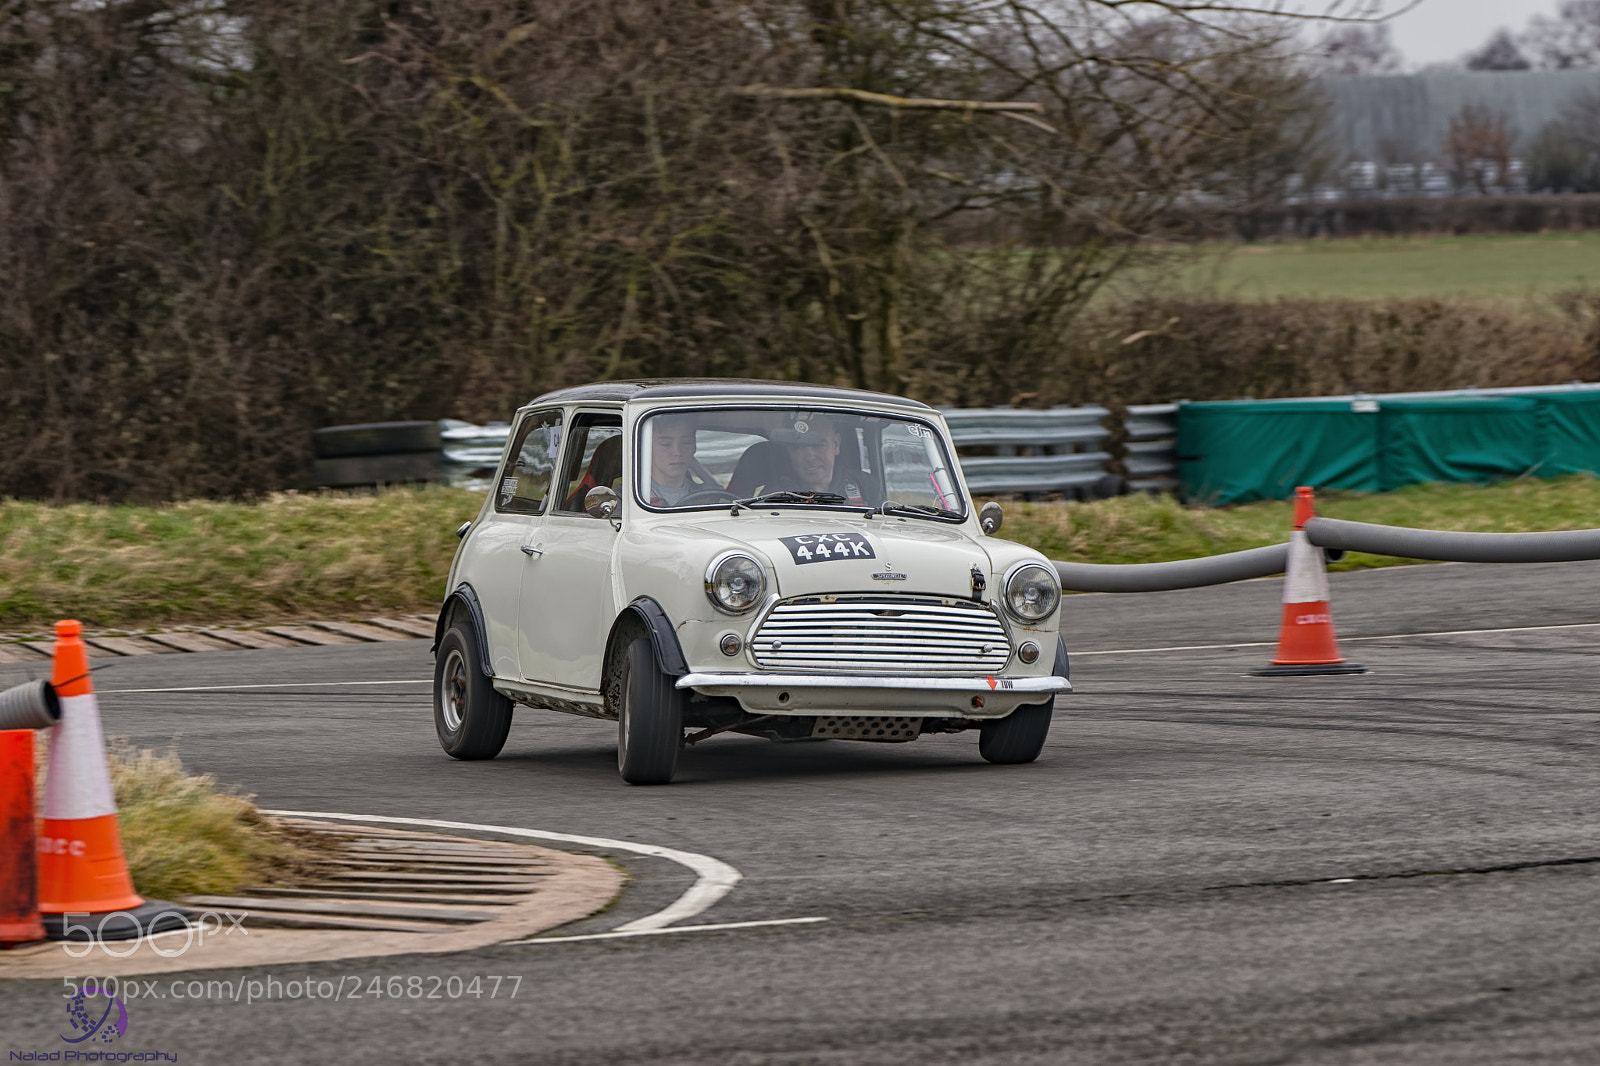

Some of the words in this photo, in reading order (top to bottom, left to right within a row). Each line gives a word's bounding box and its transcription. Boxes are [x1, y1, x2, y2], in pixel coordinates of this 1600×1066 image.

[794, 533, 851, 544] CXC
[796, 541, 870, 560] 444K
[885, 562, 892, 572] S
